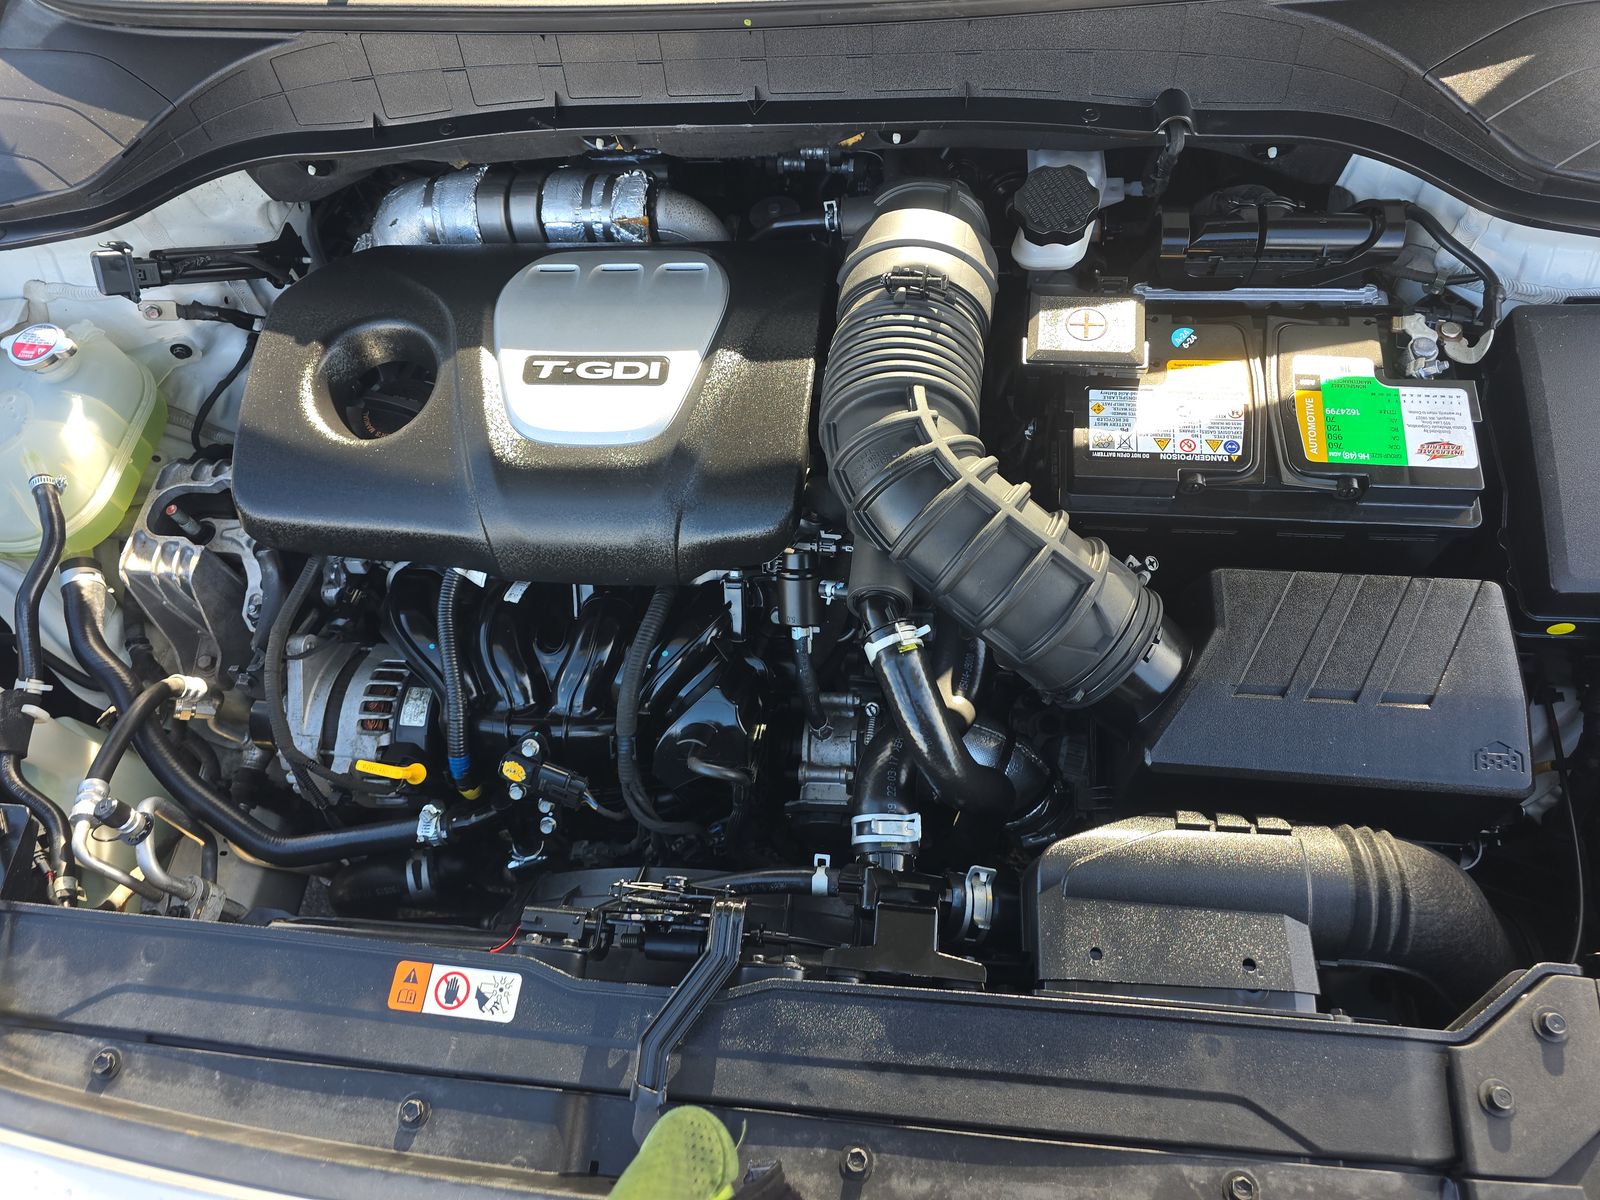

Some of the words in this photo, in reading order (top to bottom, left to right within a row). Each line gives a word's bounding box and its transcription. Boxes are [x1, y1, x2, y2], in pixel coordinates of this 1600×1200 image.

[1182, 334, 1198, 348] 6-24
[532, 360, 662, 380] T-GDI
[1326, 408, 1360, 416] 1624799
[1305, 397, 1318, 454] AUTOMOTIVE
[1160, 453, 1229, 462] DANGER/POISON
[1343, 451, 1356, 460] (48)
